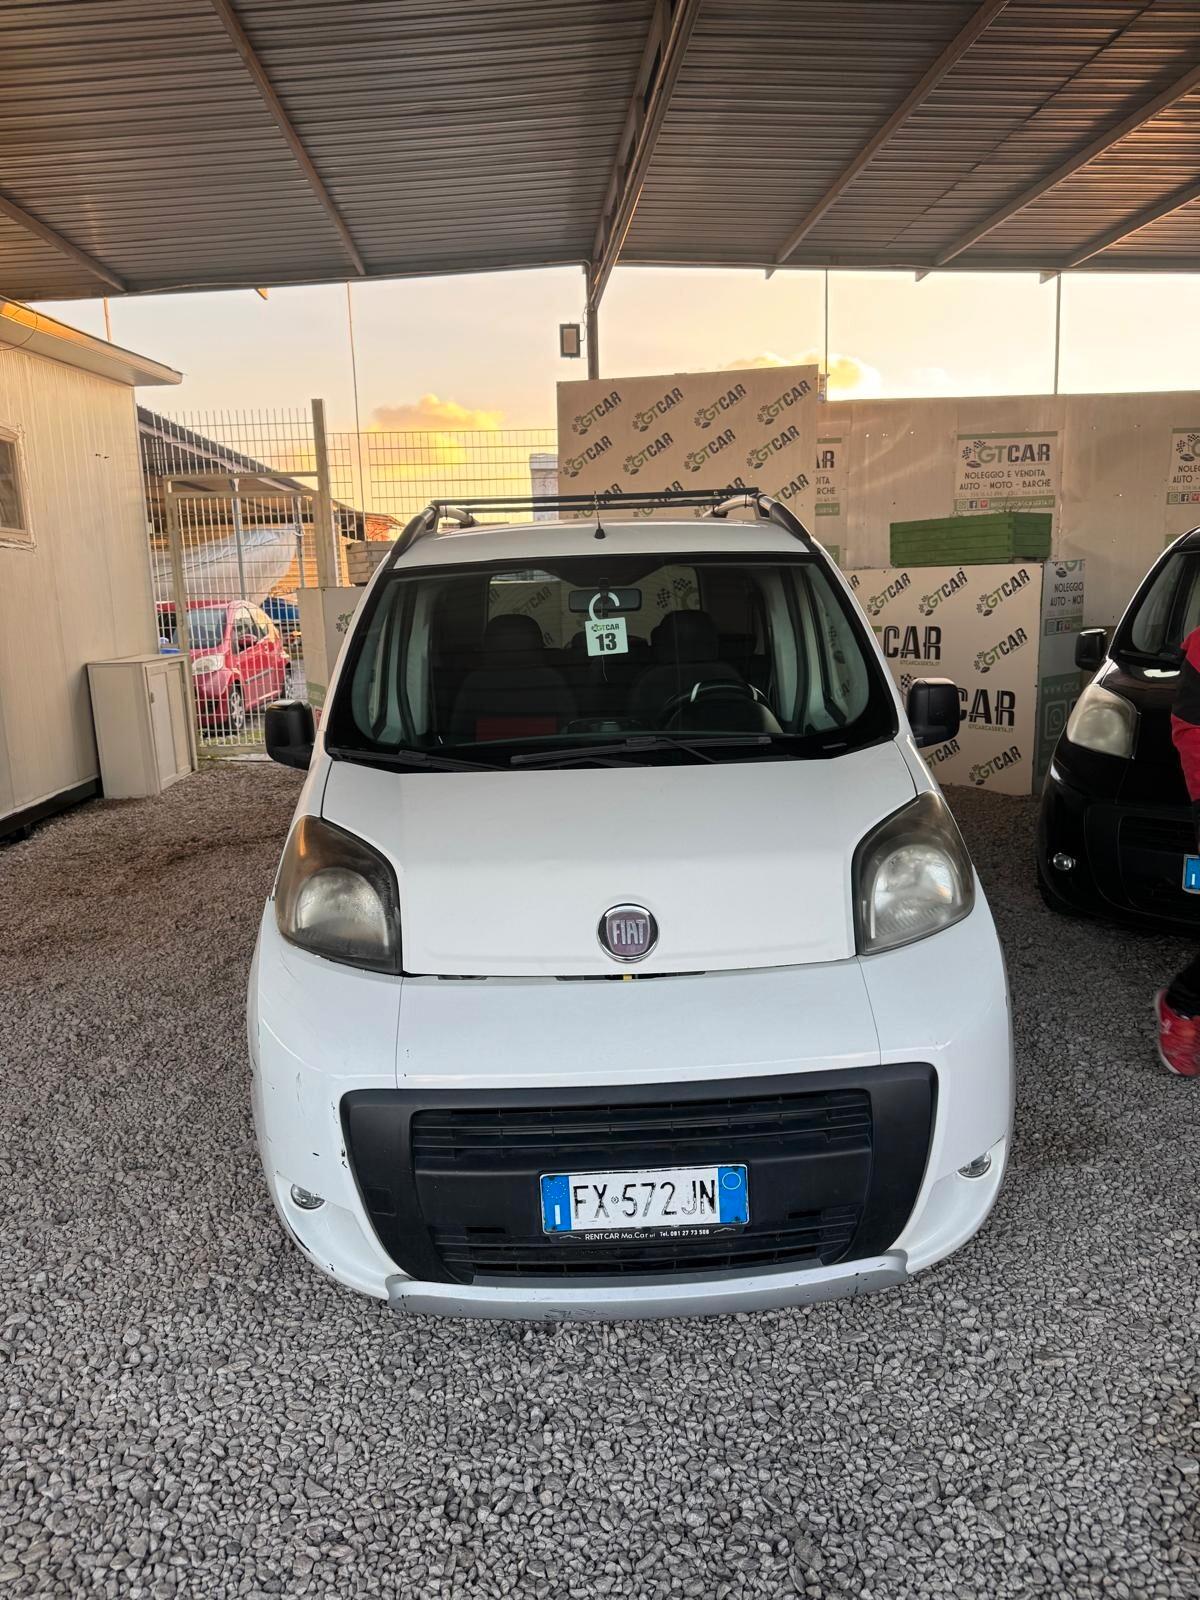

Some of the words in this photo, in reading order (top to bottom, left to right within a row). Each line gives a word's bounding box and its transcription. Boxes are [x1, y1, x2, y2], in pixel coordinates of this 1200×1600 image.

[580, 391, 622, 428] GTCAR
[640, 387, 684, 425] GTCAR
[703, 383, 747, 421] GTCAR
[766, 380, 811, 418] GTCAR
[571, 435, 613, 470] GTCAR
[631, 432, 674, 468] GTCAR
[693, 428, 736, 465] GTCAR
[755, 425, 800, 462] GTCAR
[977, 444, 1051, 463] GTCAR
[959, 482, 980, 491] AUTO
[989, 481, 1013, 489] MOTO
[1022, 479, 1051, 488] BARCHE
[964, 470, 1004, 480] NOLEGGIO
[1014, 469, 1046, 478] VENDITA
[1172, 475, 1192, 483] AUTO
[1178, 465, 1200, 473] NOLE
[771, 473, 809, 503] TCAR
[817, 487, 836, 495] RCHE
[874, 572, 911, 608] GTCAR
[927, 570, 968, 608] GTCAR
[985, 568, 1030, 608] GTCAR
[1050, 596, 1066, 606] AUTO
[1072, 595, 1084, 605] MOT
[595, 633, 617, 651] 13
[872, 625, 942, 660] CAR
[983, 627, 1028, 666] GTCAR
[957, 687, 1016, 726] CAR
[978, 745, 1022, 779] GTCAR
[612, 919, 646, 945] FIAT
